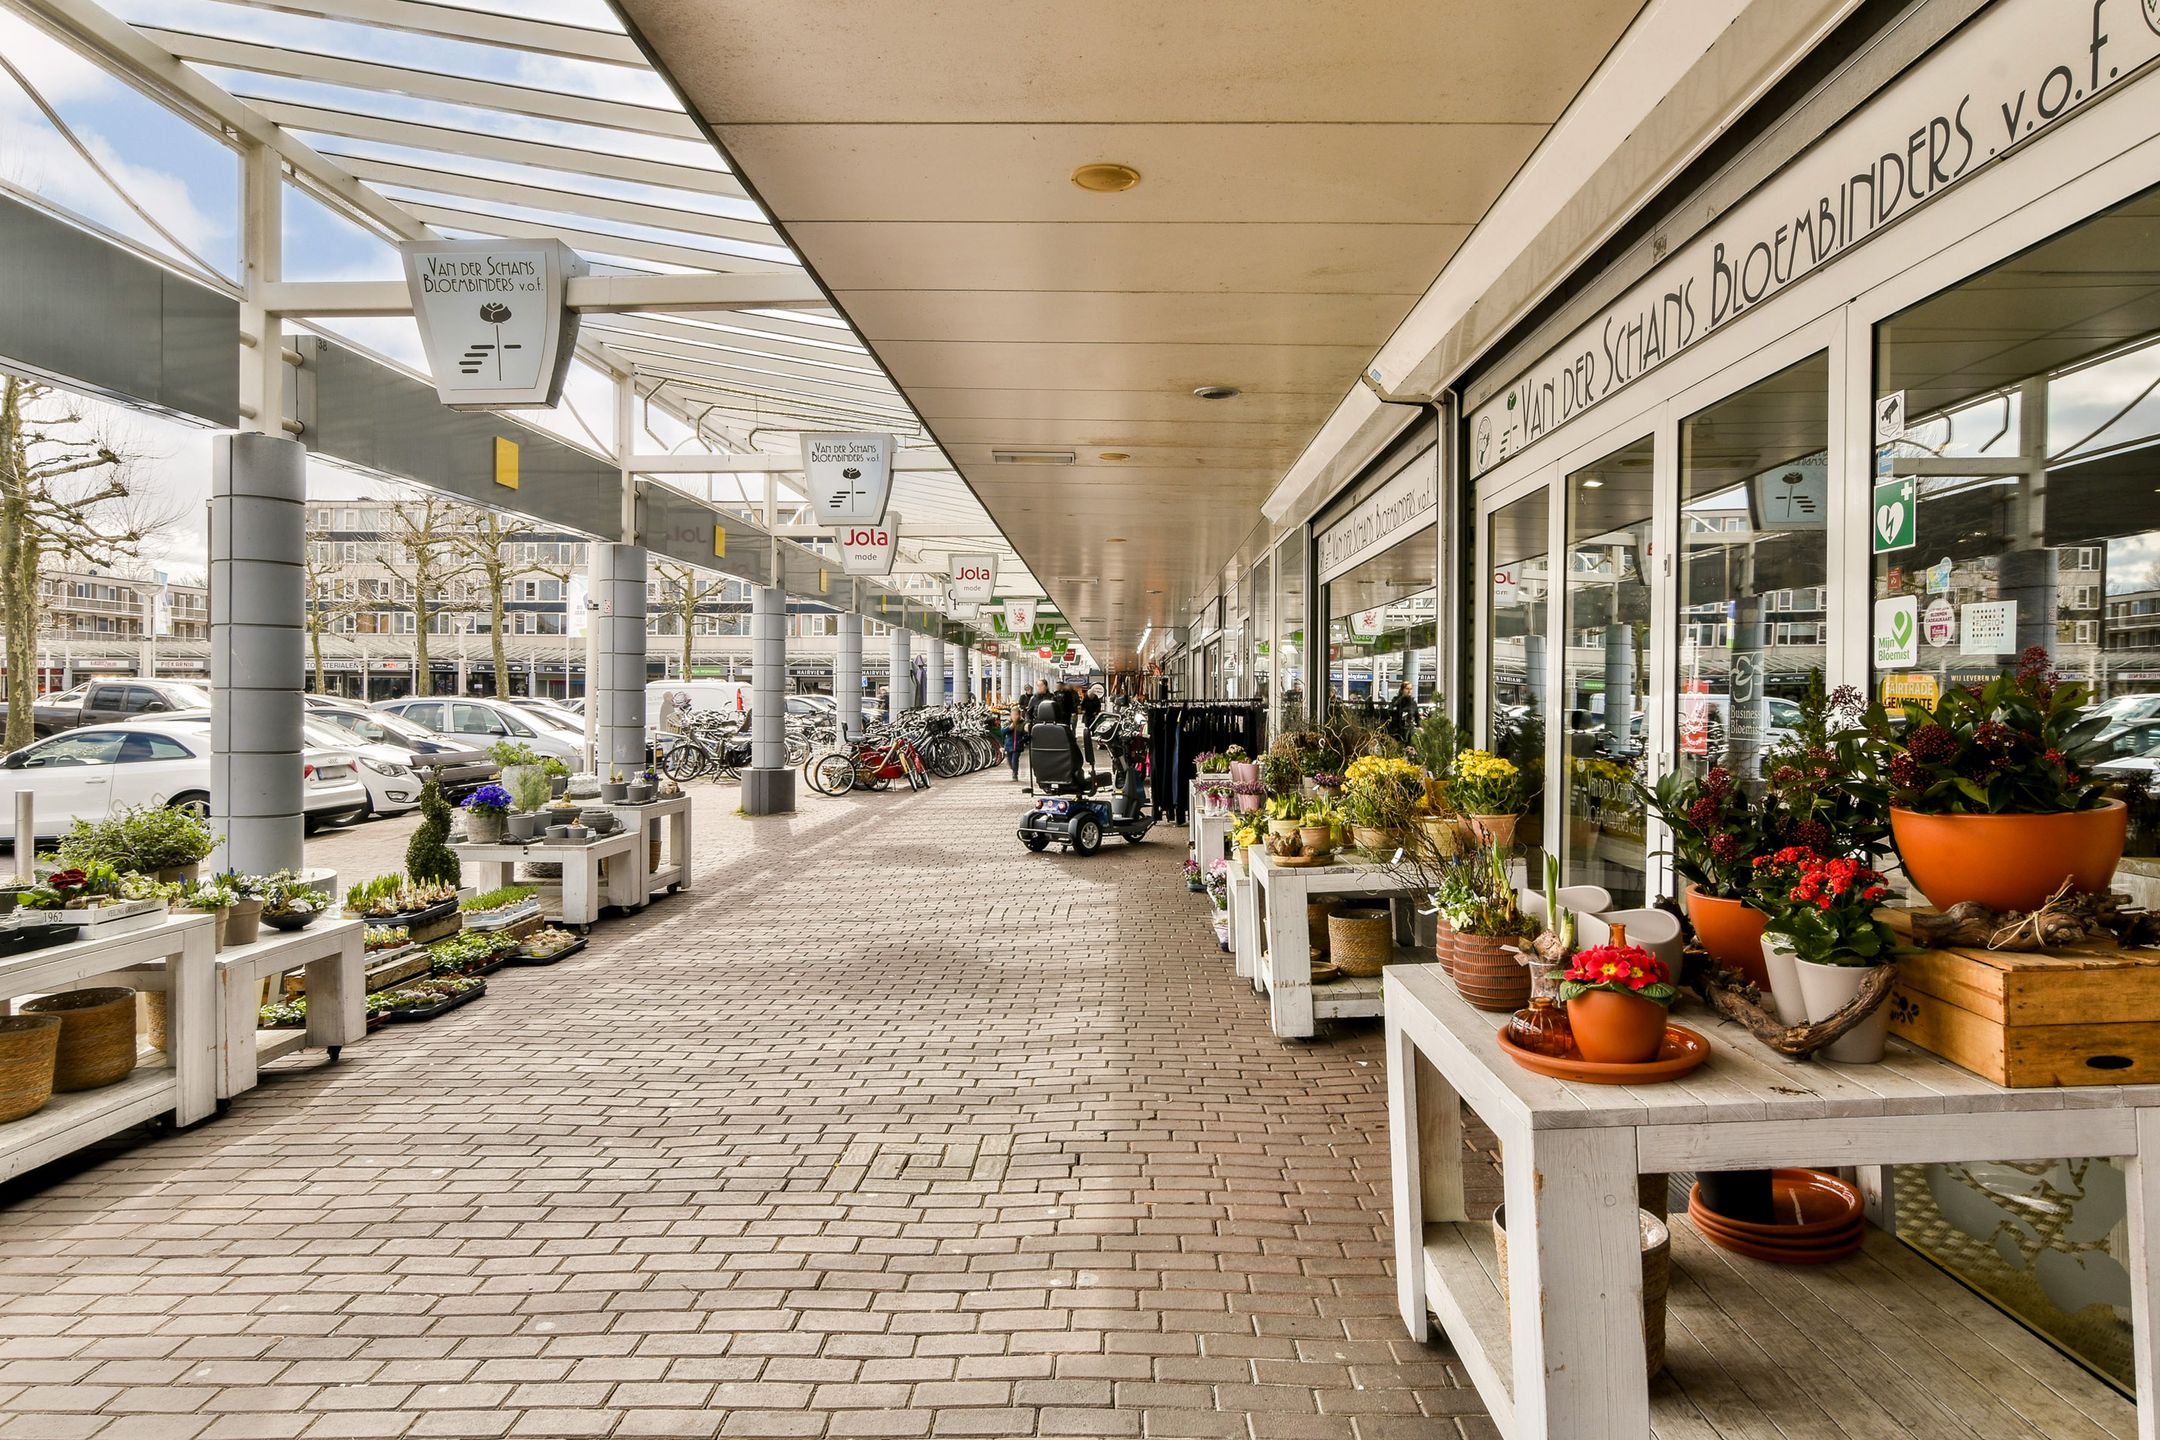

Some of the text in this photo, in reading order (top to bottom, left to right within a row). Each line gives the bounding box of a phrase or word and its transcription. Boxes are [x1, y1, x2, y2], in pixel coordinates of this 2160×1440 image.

[844, 528, 888, 546] Jola
[854, 552, 878, 561] mode
[955, 566, 990, 581] Jola
[963, 584, 982, 592] mode
[1879, 637, 1895, 652] Mijn
[1878, 649, 1910, 661] Bloemist
[1885, 682, 1933, 696] FAIRTRADE
[1730, 706, 1761, 720] Business
[43, 911, 64, 923] 1962
